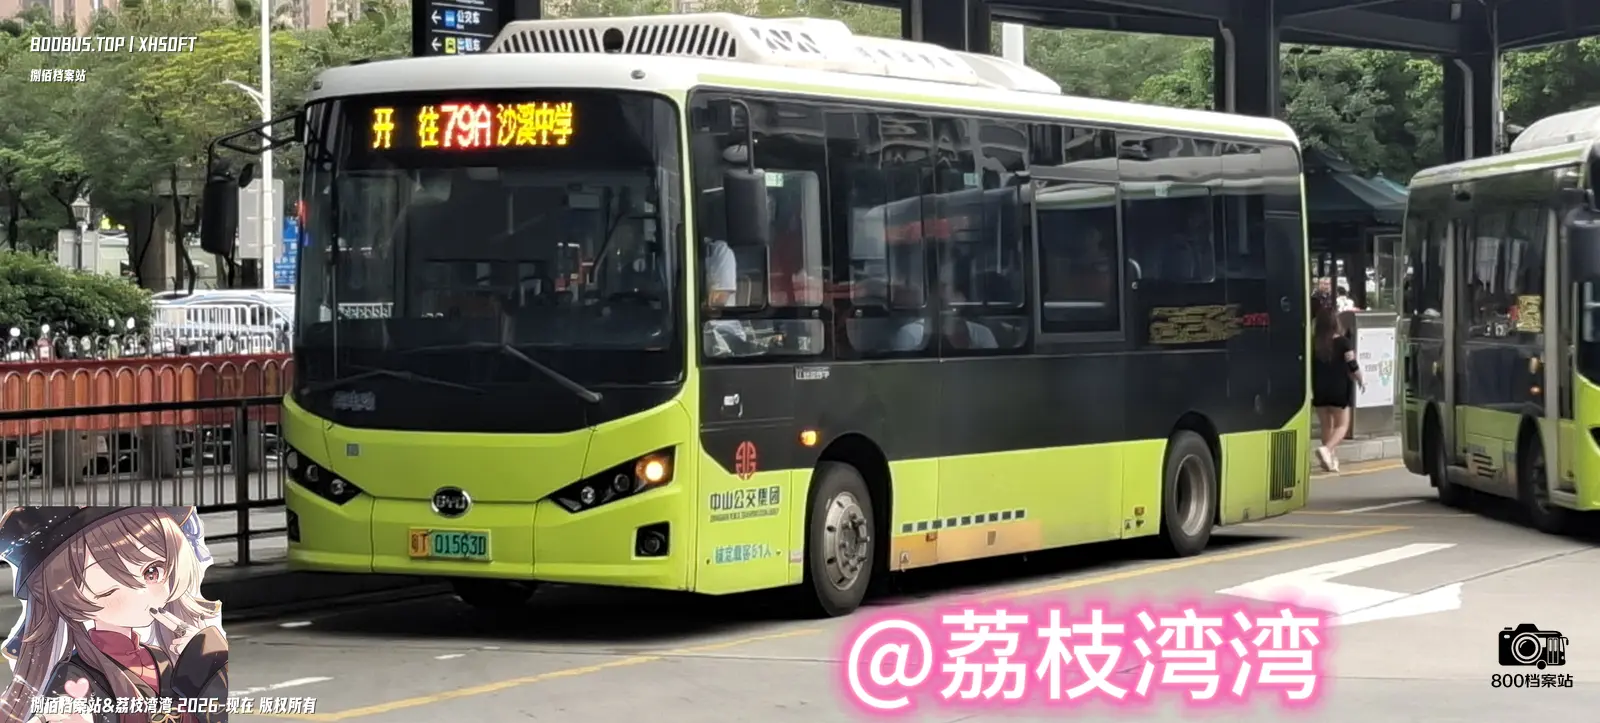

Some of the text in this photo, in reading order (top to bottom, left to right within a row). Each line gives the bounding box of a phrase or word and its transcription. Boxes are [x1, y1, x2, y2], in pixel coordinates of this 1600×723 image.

[710, 486, 780, 511] 中山公交集团
